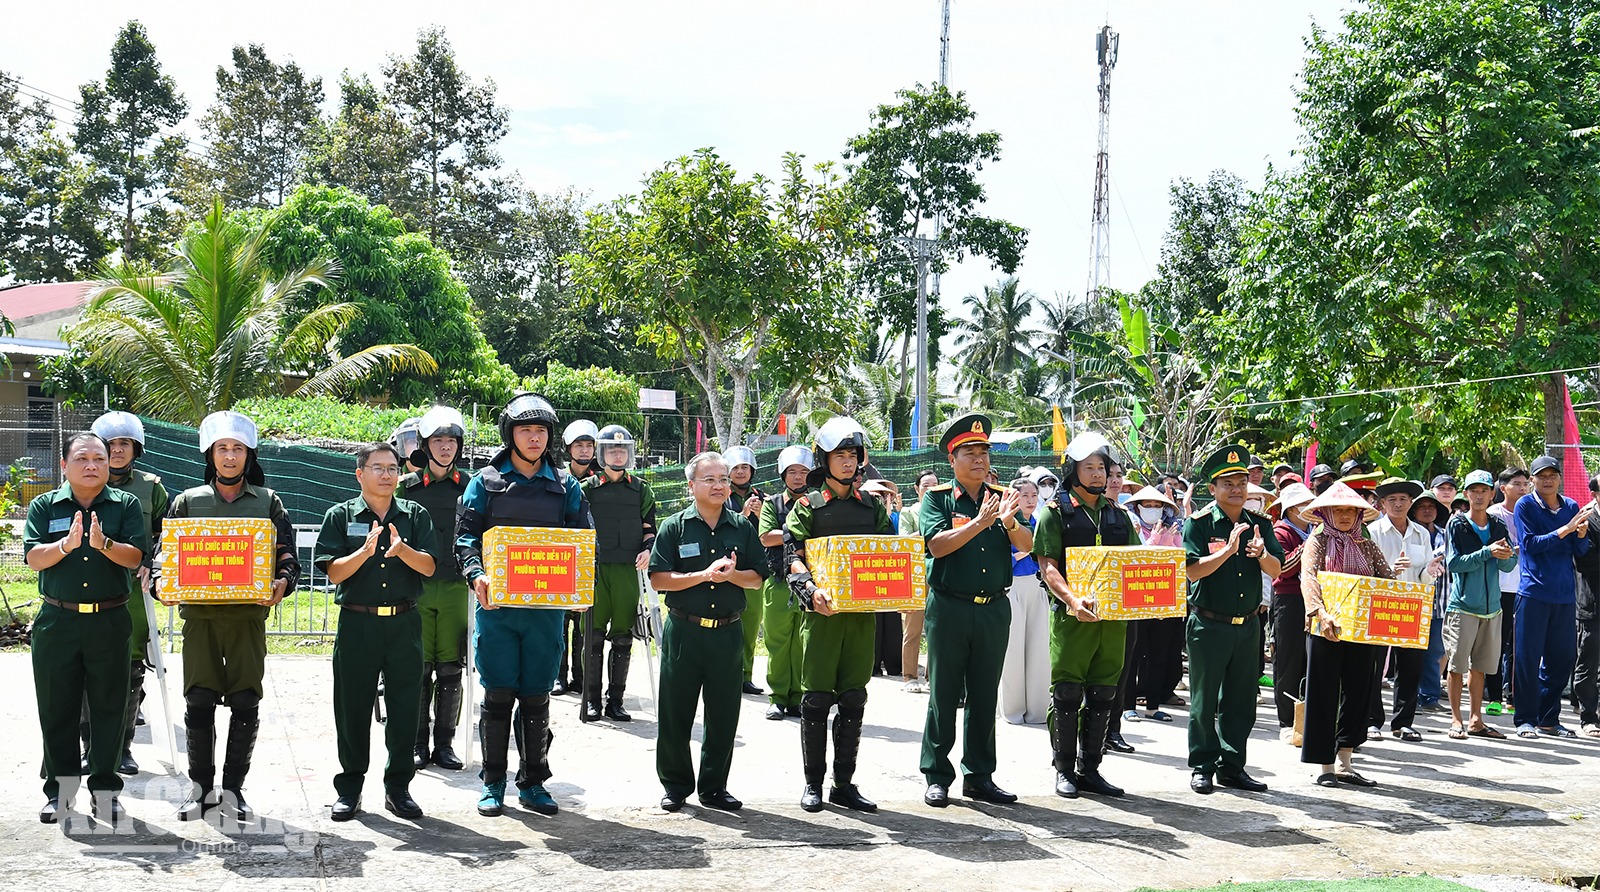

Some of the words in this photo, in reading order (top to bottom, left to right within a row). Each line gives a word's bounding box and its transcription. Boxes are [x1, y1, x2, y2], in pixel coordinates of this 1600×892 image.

[182, 542, 194, 551] BAN
[510, 551, 522, 560] BAN
[208, 571, 222, 582] Tặng
